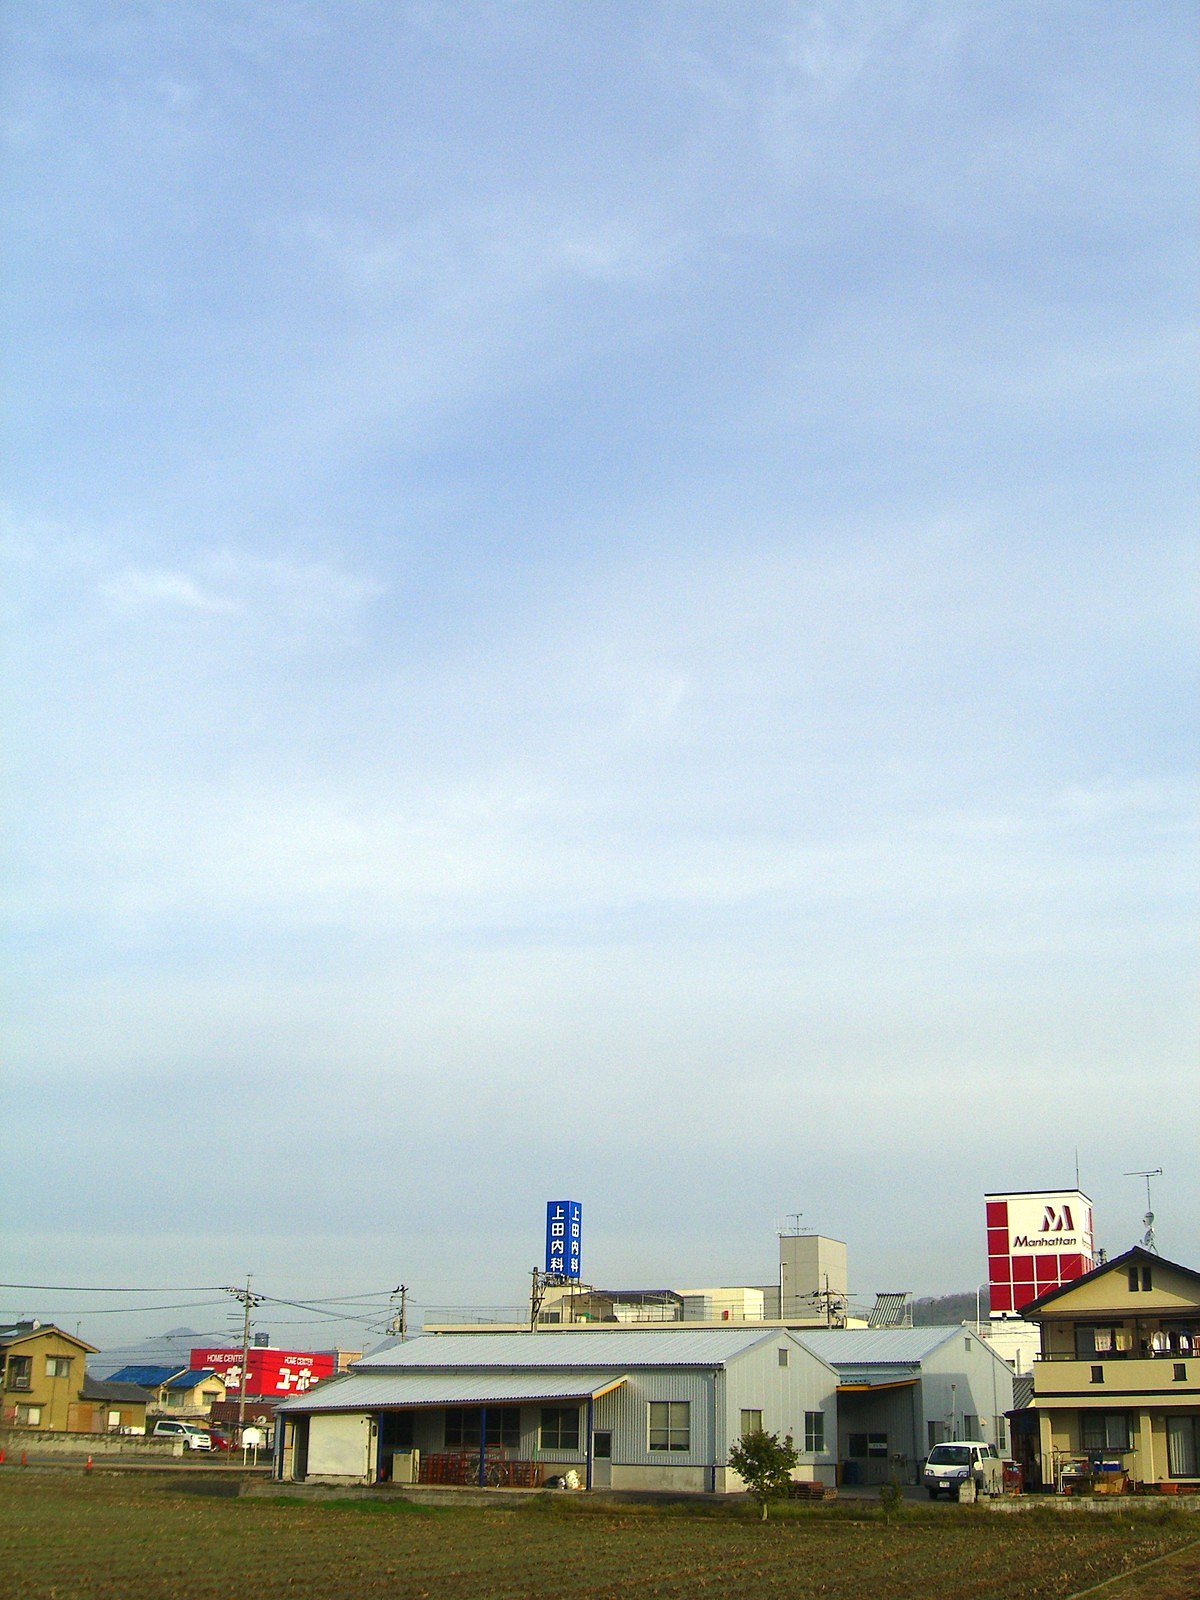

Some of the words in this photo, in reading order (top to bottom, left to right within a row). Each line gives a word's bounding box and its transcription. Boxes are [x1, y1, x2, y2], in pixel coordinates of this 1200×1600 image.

[550, 1205, 564, 1271] 上田内科
[571, 1207, 579, 1272] 上田内科
[1013, 1236, 1076, 1248] Manhattan
[207, 1354, 223, 1363] HOME
[224, 1354, 244, 1363] CENTE
[284, 1356, 297, 1365] HOME
[297, 1357, 313, 1366] CENTER
[276, 1368, 319, 1390] ユーホー
